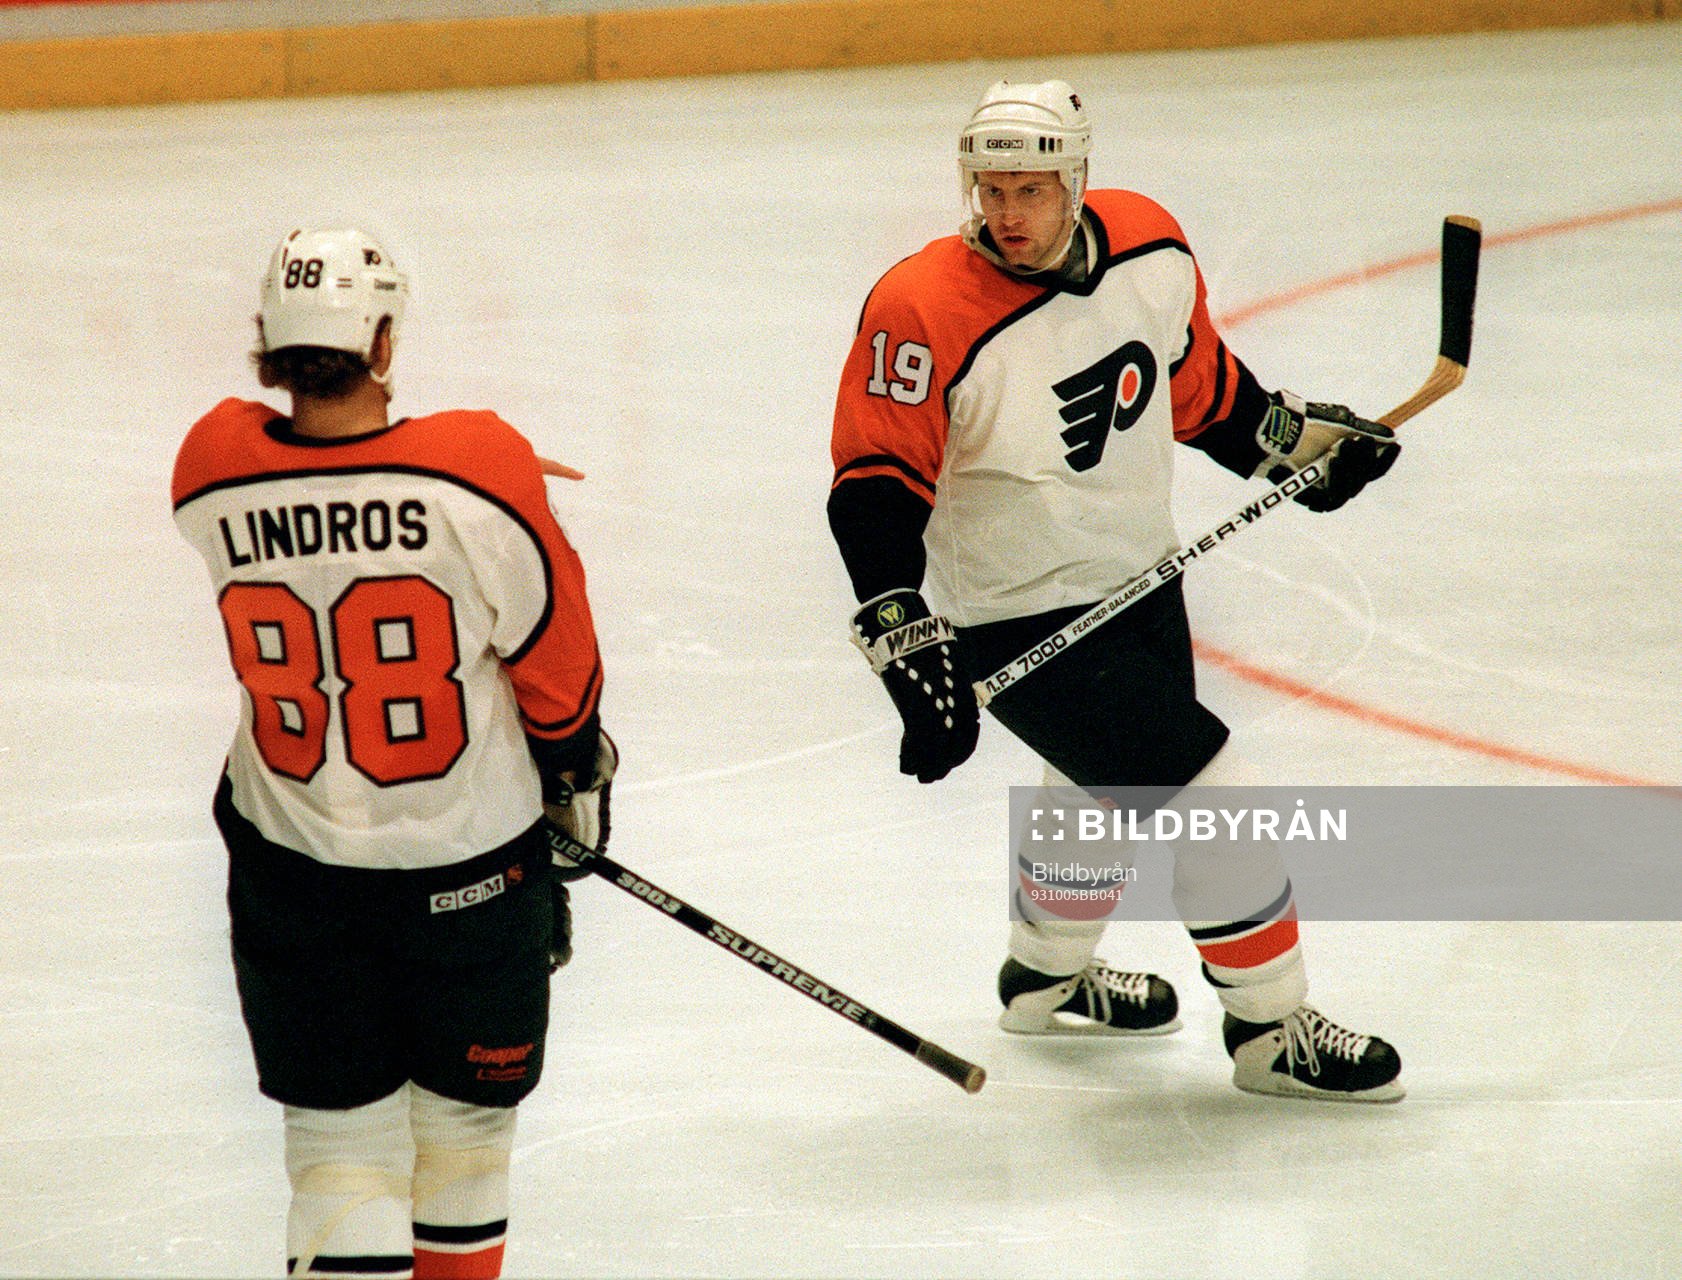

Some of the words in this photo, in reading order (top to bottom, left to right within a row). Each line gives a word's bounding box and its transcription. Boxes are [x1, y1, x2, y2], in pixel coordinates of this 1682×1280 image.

[987, 139, 1024, 149] CCM
[284, 258, 324, 289] 88
[866, 330, 934, 406] 19
[219, 500, 428, 568] LINDROS
[1016, 633, 1067, 673] 7000
[1072, 578, 1151, 636] FEATHER-BALANCED
[1155, 465, 1321, 581] SHER-WOOD
[218, 574, 470, 788] 88
[433, 876, 503, 911] CCM
[707, 924, 868, 1021] SUPREME
